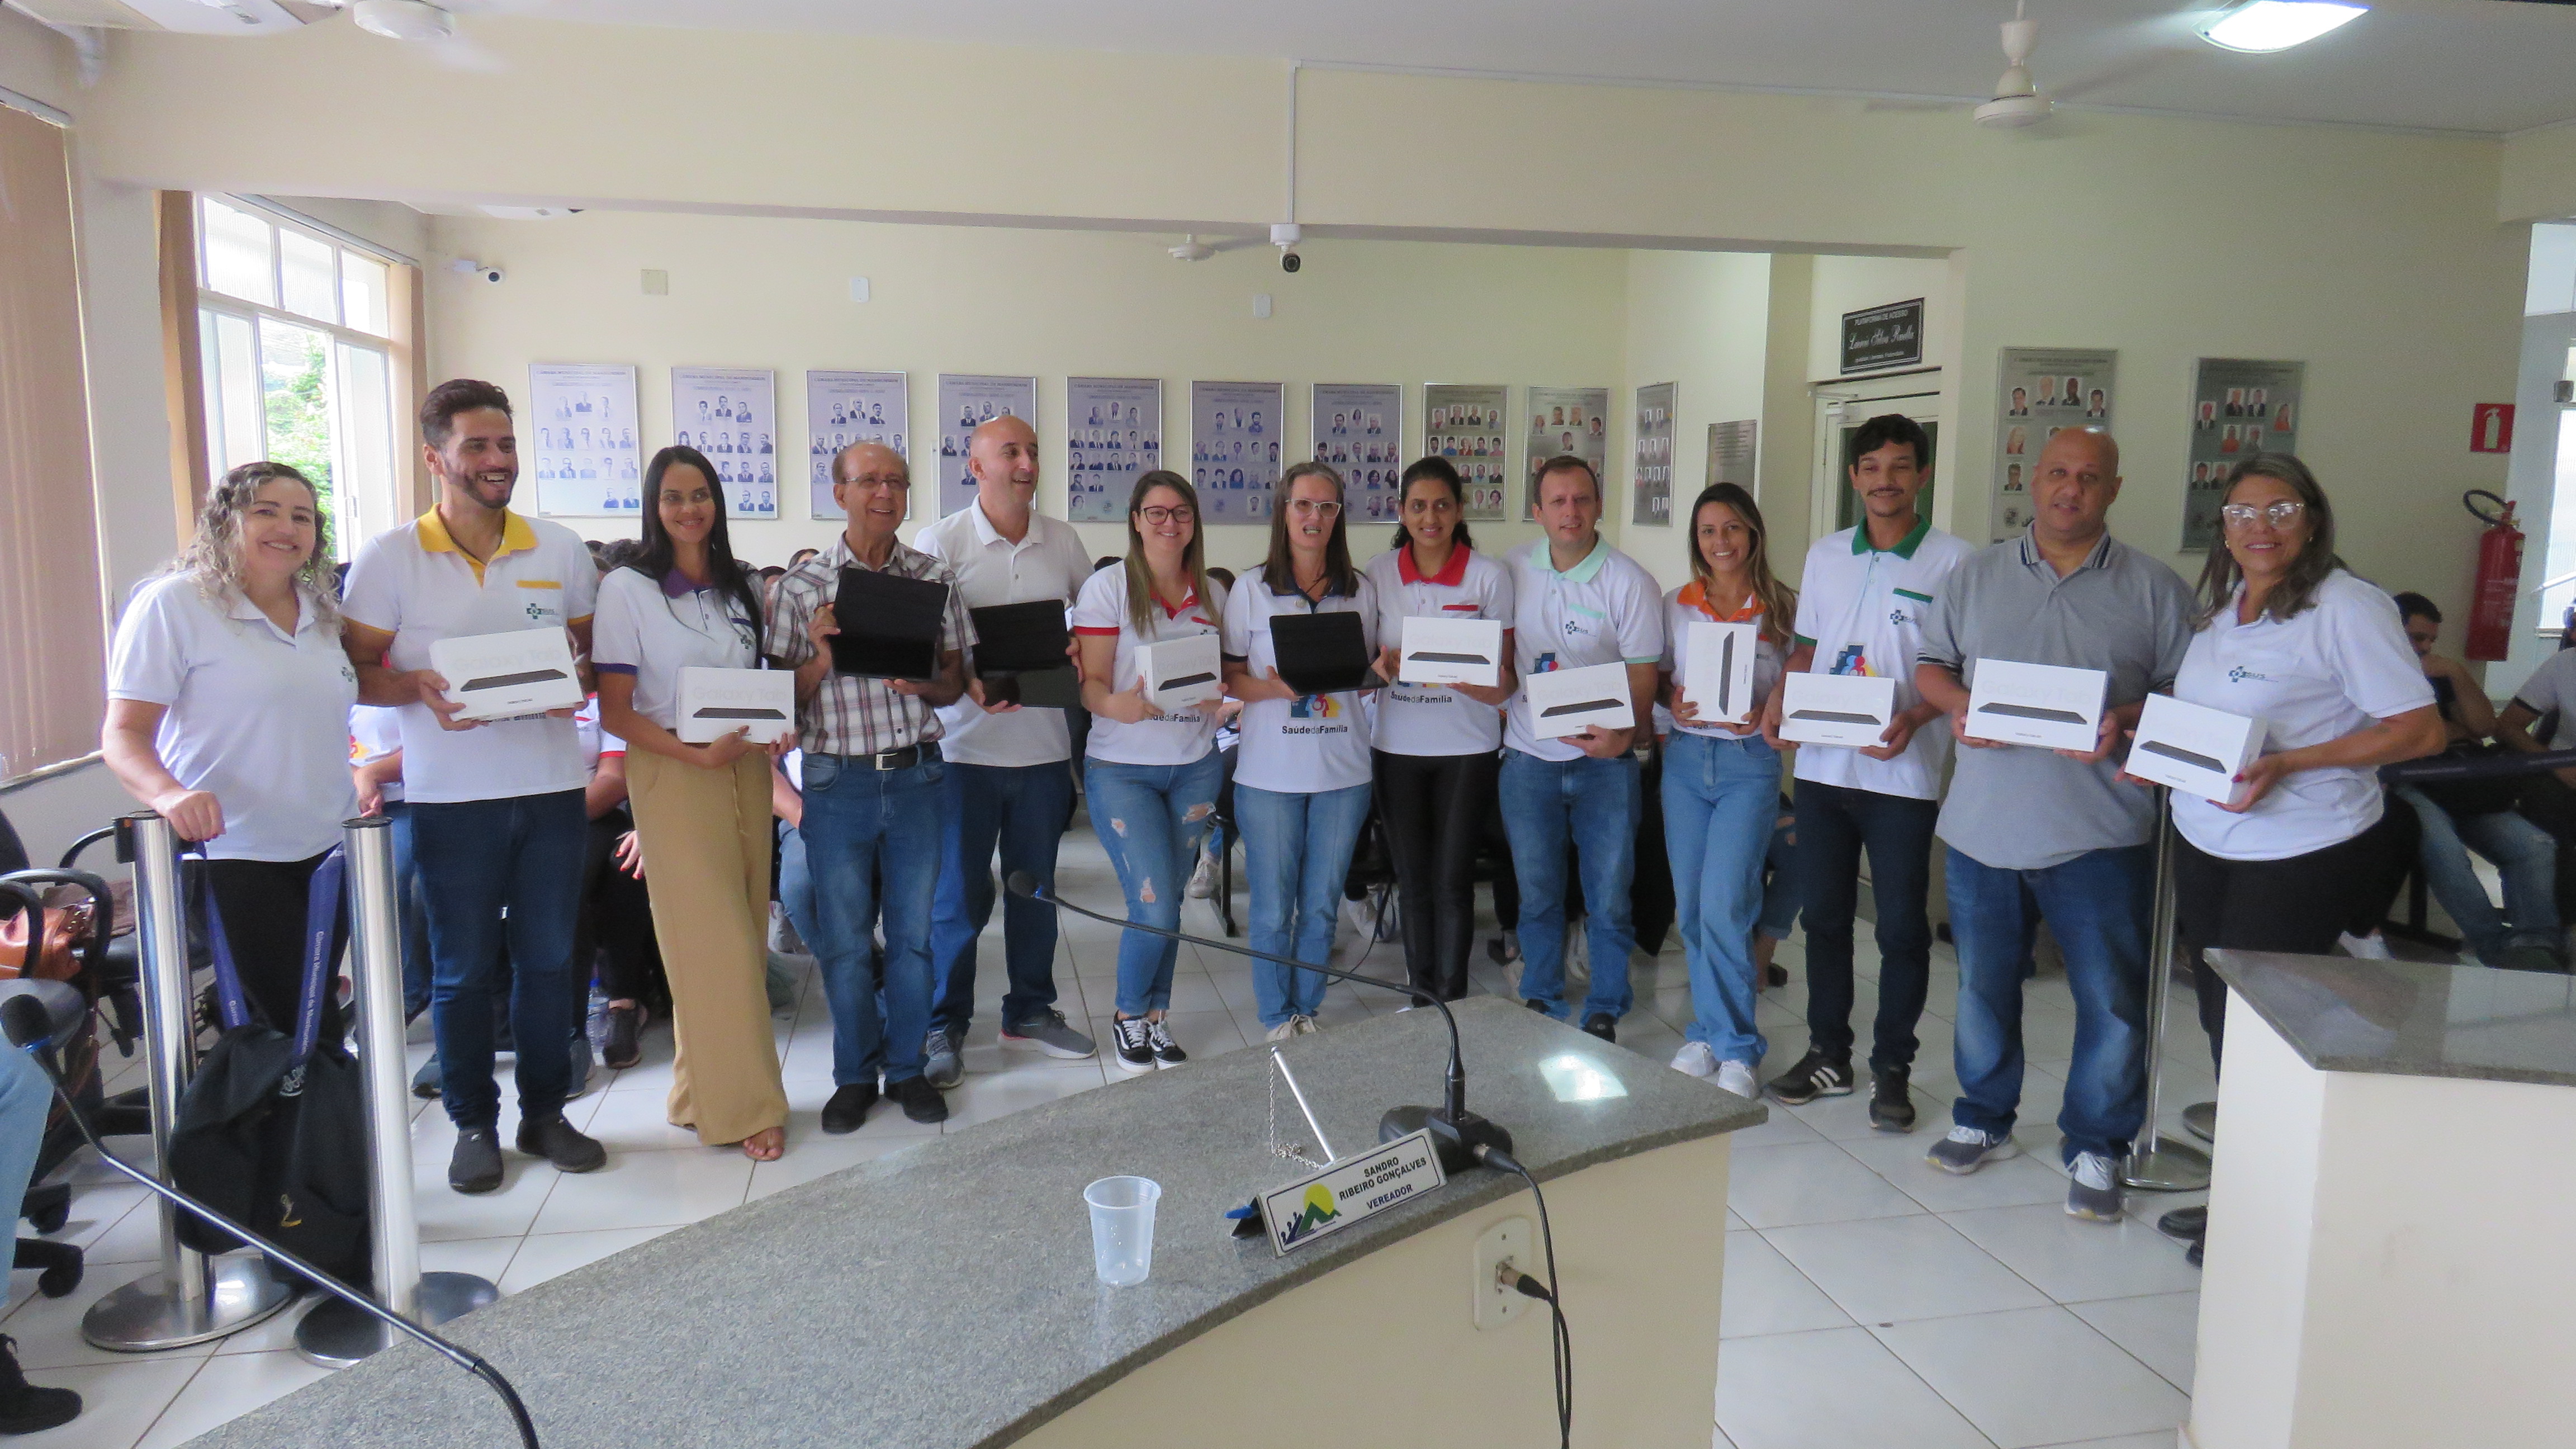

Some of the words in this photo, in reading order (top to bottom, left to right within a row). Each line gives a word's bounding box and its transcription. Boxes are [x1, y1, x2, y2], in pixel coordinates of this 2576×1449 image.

[1339, 1179, 1375, 1201] RIBEIRO
[1376, 1157, 1427, 1185] GONÇALVES
[1364, 1157, 1399, 1178] SANDRO
[1366, 1184, 1413, 1210] VEREADOR
